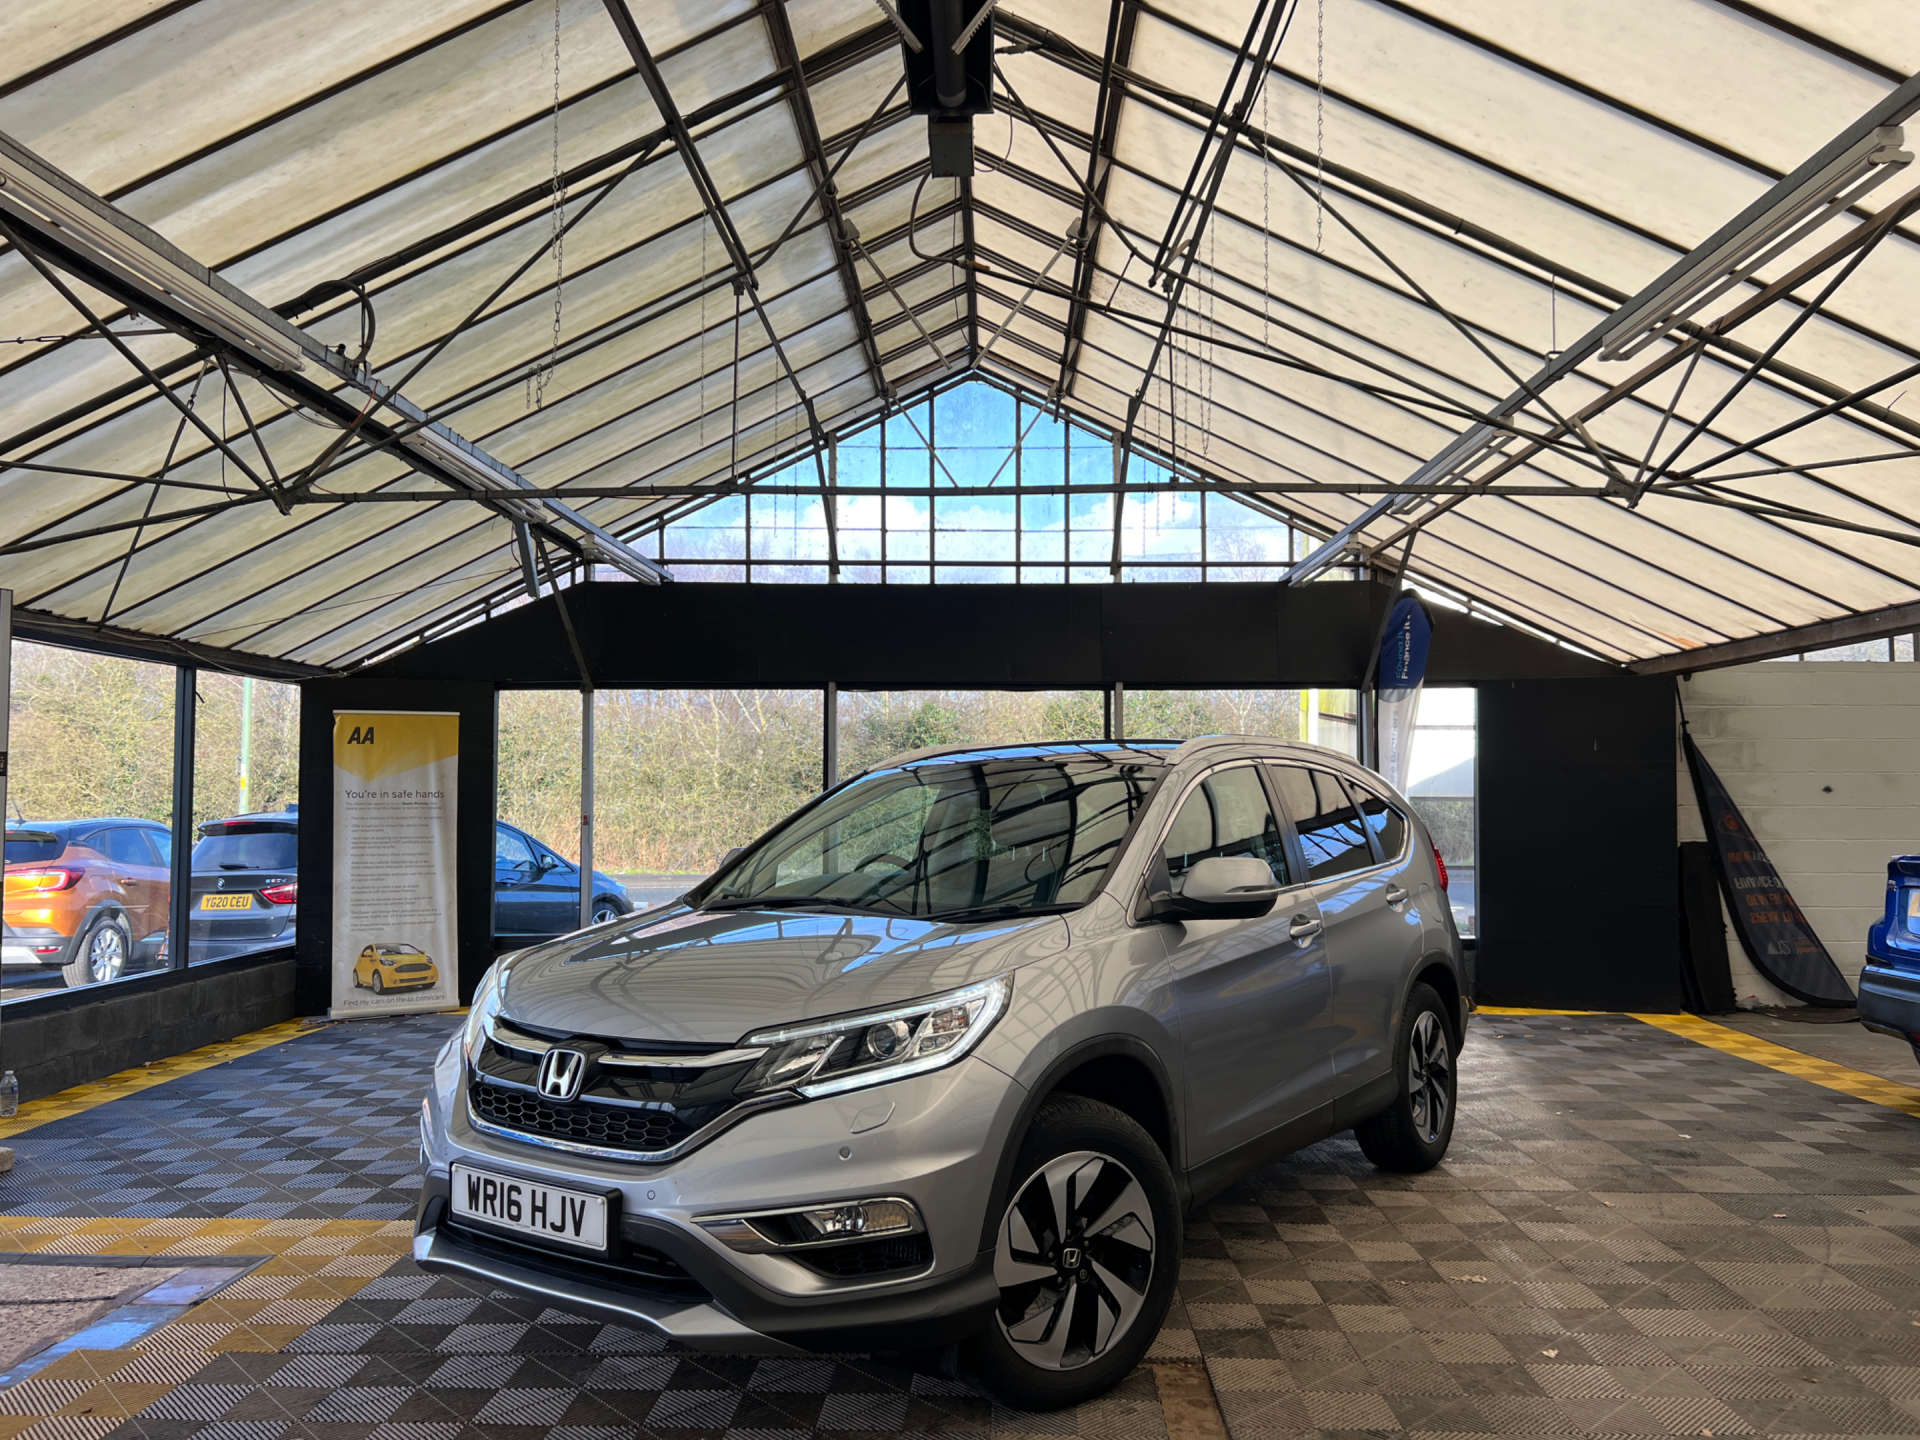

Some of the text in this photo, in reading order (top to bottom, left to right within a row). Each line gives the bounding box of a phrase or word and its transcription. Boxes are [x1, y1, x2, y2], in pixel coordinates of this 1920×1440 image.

[346, 726, 375, 745] AA
[345, 790, 445, 799] You're in safe hands
[205, 895, 250, 908] YG20 CEU
[467, 1173, 587, 1237] WR16 HJV
